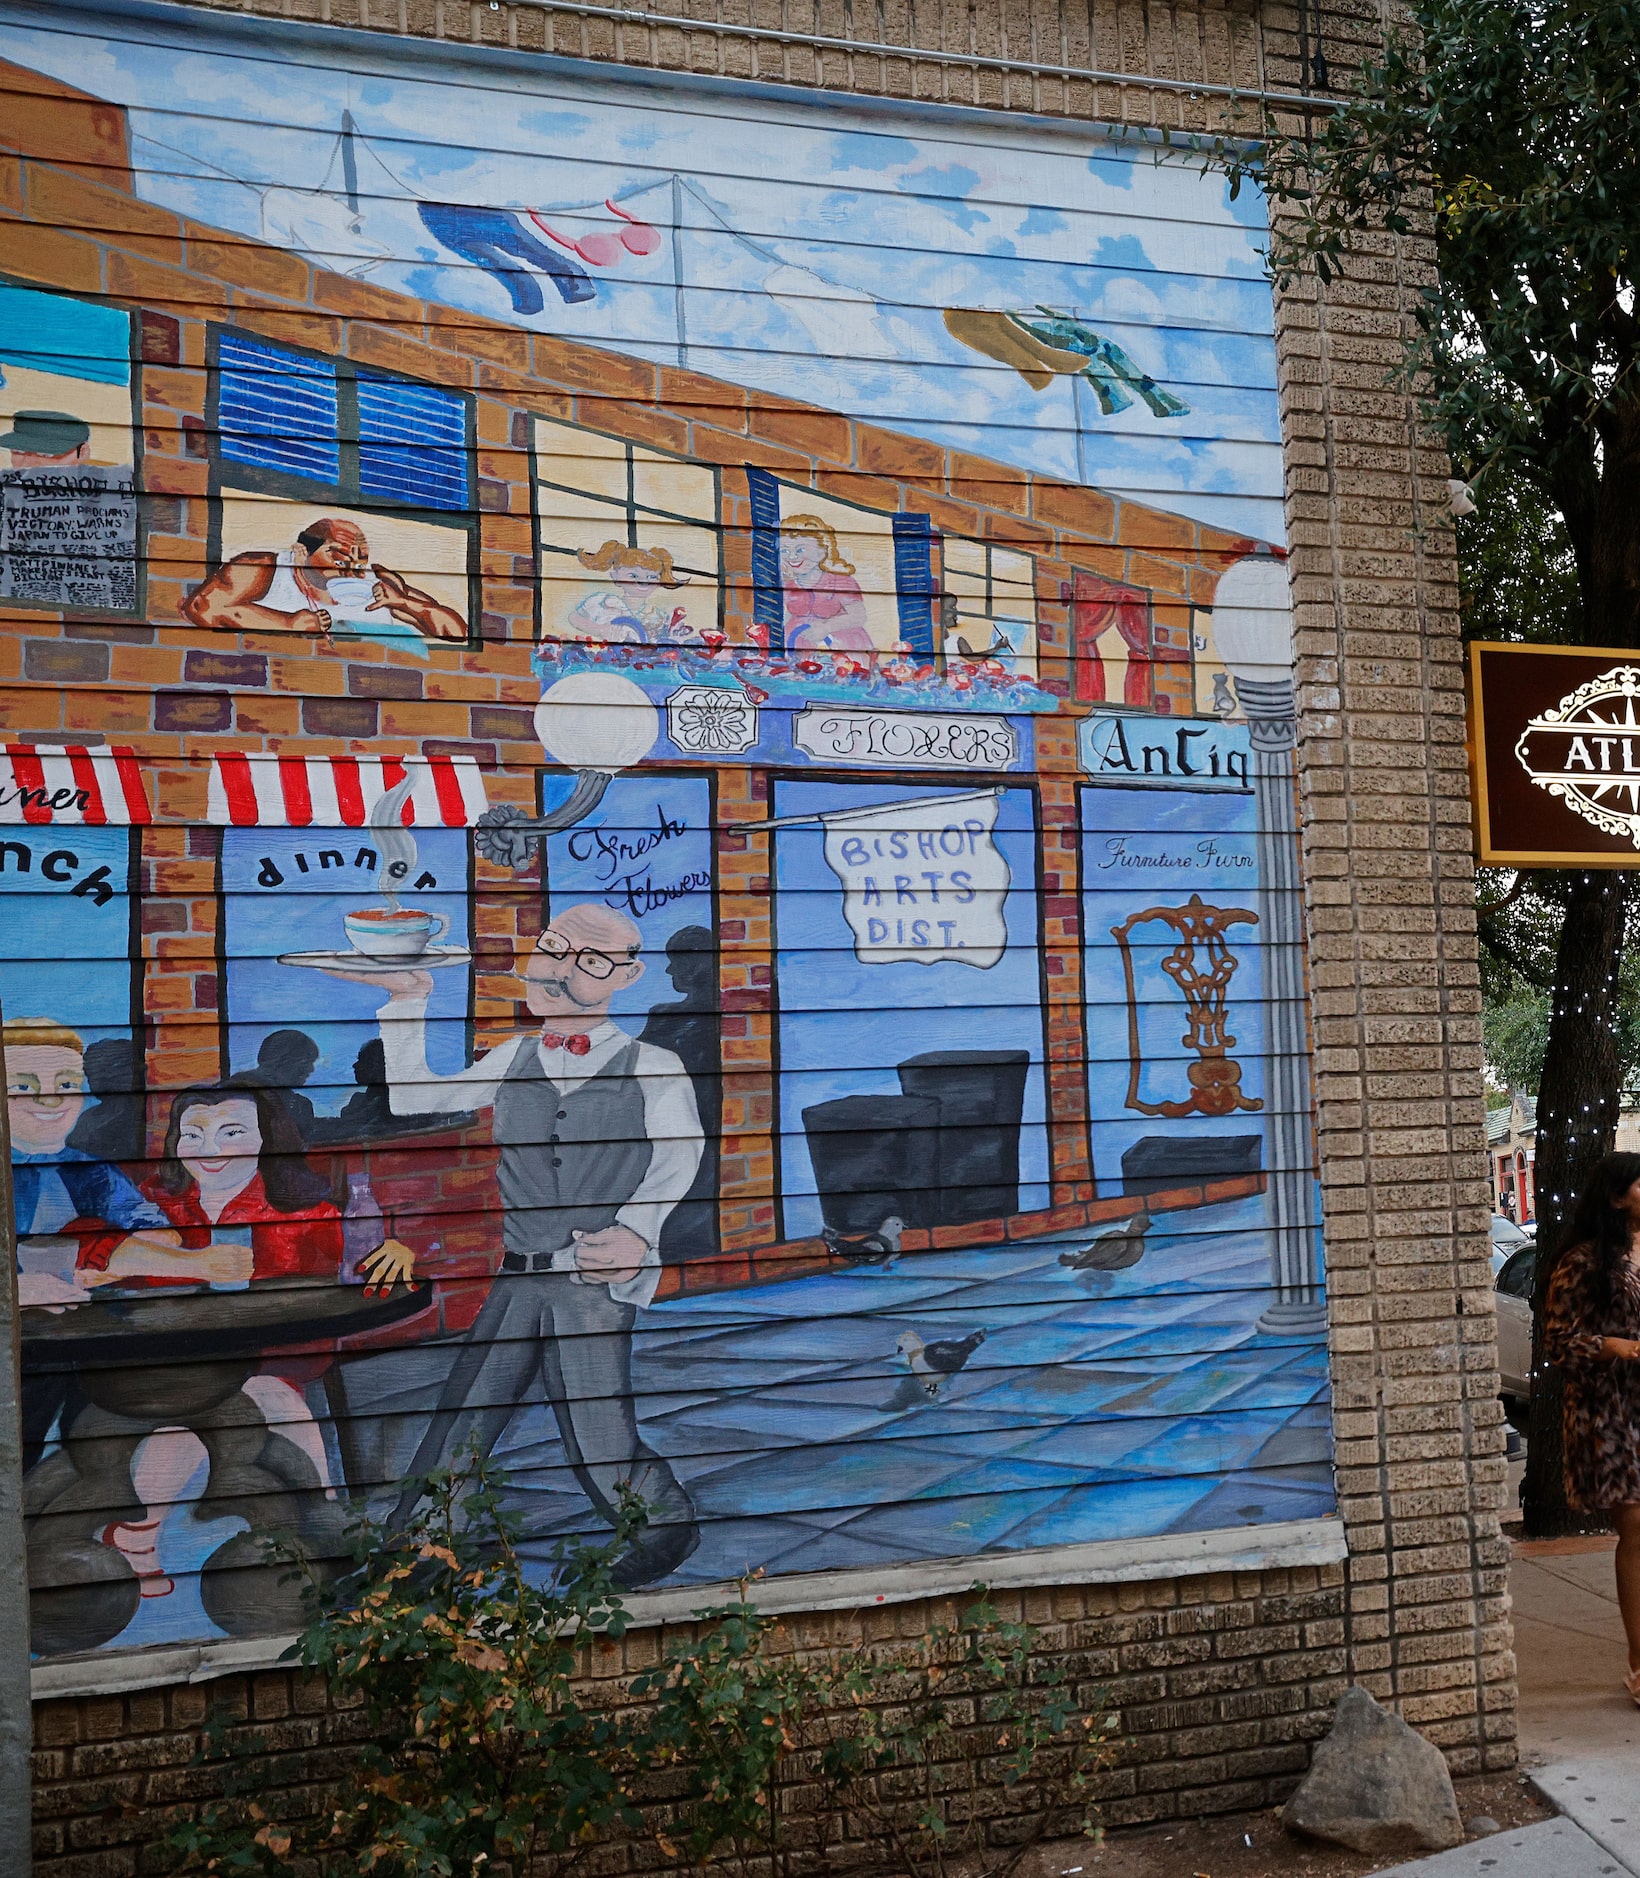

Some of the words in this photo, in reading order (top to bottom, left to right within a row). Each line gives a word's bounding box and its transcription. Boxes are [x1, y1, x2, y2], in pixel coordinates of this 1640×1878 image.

[6, 505, 70, 519] TRUMAN
[77, 517, 122, 528] WARNS
[8, 530, 49, 540] JAPAN
[53, 530, 68, 540] TO
[70, 530, 102, 540] GIVE
[105, 530, 118, 539] UP
[820, 716, 1011, 763] FLOWERS
[568, 804, 687, 880] Fresh
[1098, 836, 1192, 869] Furniture
[257, 847, 437, 888] dinner
[604, 863, 711, 917] Flowers
[863, 870, 976, 906] ARTS
[867, 917, 966, 948] DIST.
